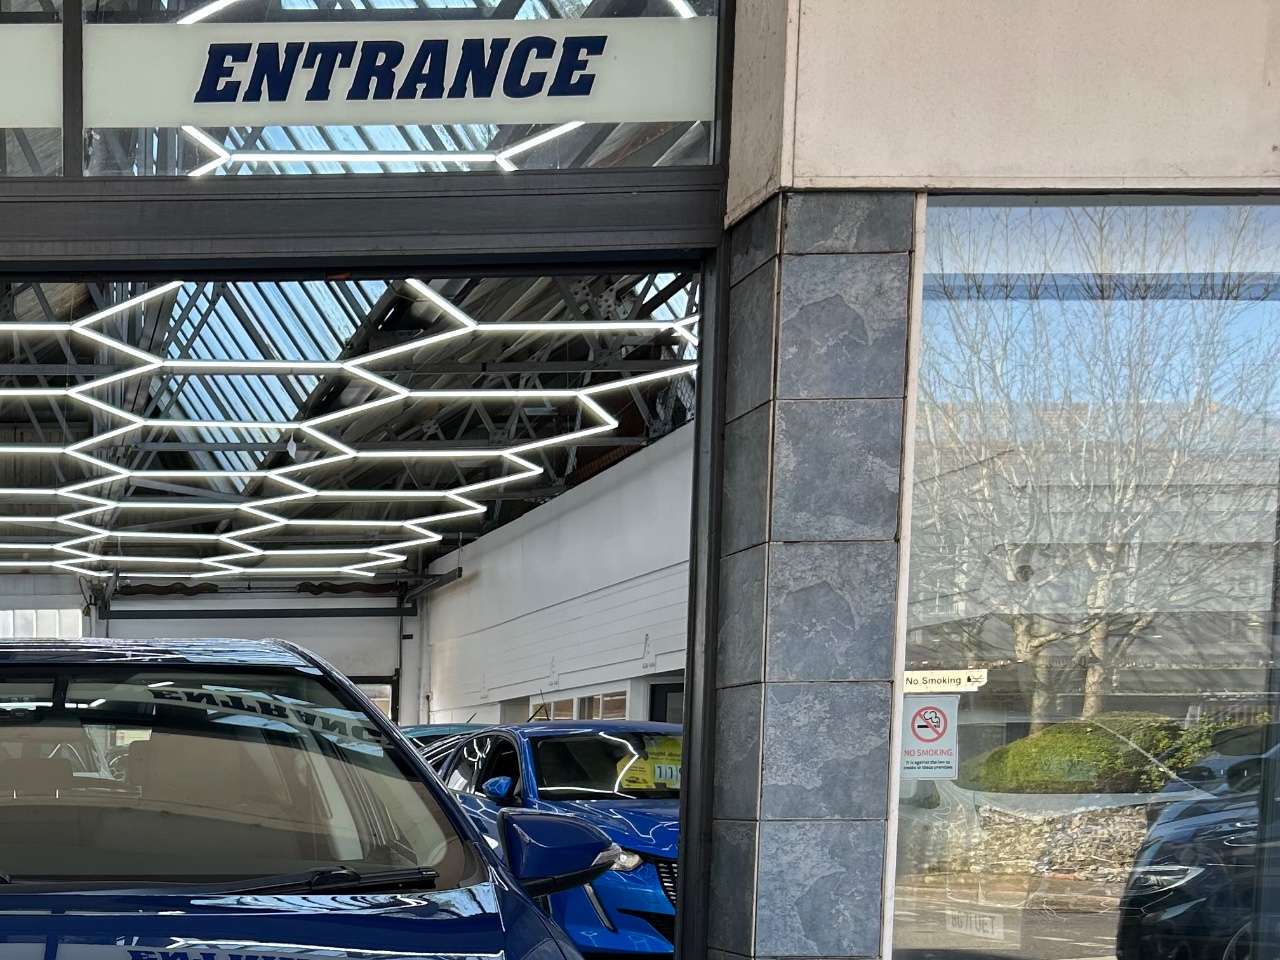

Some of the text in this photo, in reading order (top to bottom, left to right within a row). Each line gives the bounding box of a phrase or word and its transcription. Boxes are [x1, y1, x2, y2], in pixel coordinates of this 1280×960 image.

[194, 35, 608, 103] ENTRANCE
[906, 675, 962, 686] No Smoking
